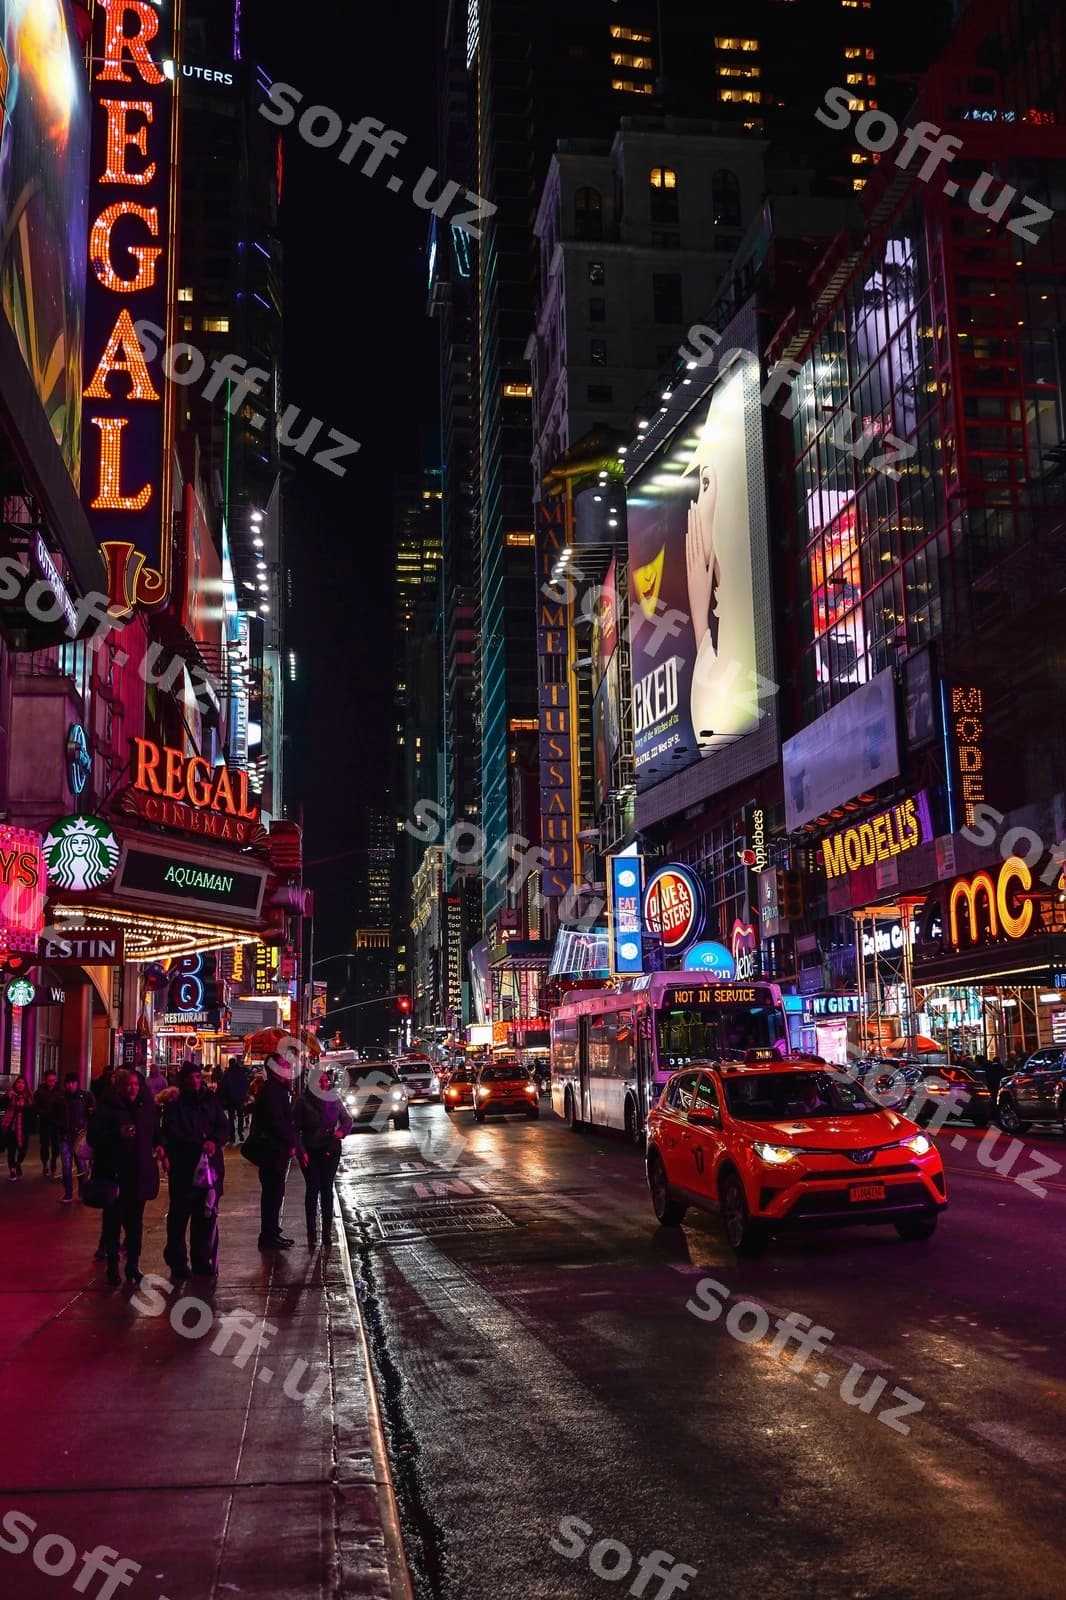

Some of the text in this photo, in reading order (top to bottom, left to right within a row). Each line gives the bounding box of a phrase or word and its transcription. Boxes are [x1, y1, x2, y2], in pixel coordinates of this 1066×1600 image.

[83, 0, 167, 509] REGAL
[133, 737, 260, 820] REGAL
[145, 800, 246, 842] CINEMAS
[164, 865, 234, 892] AQUAMAN
[674, 989, 756, 1003] NOT IN SERVICE
